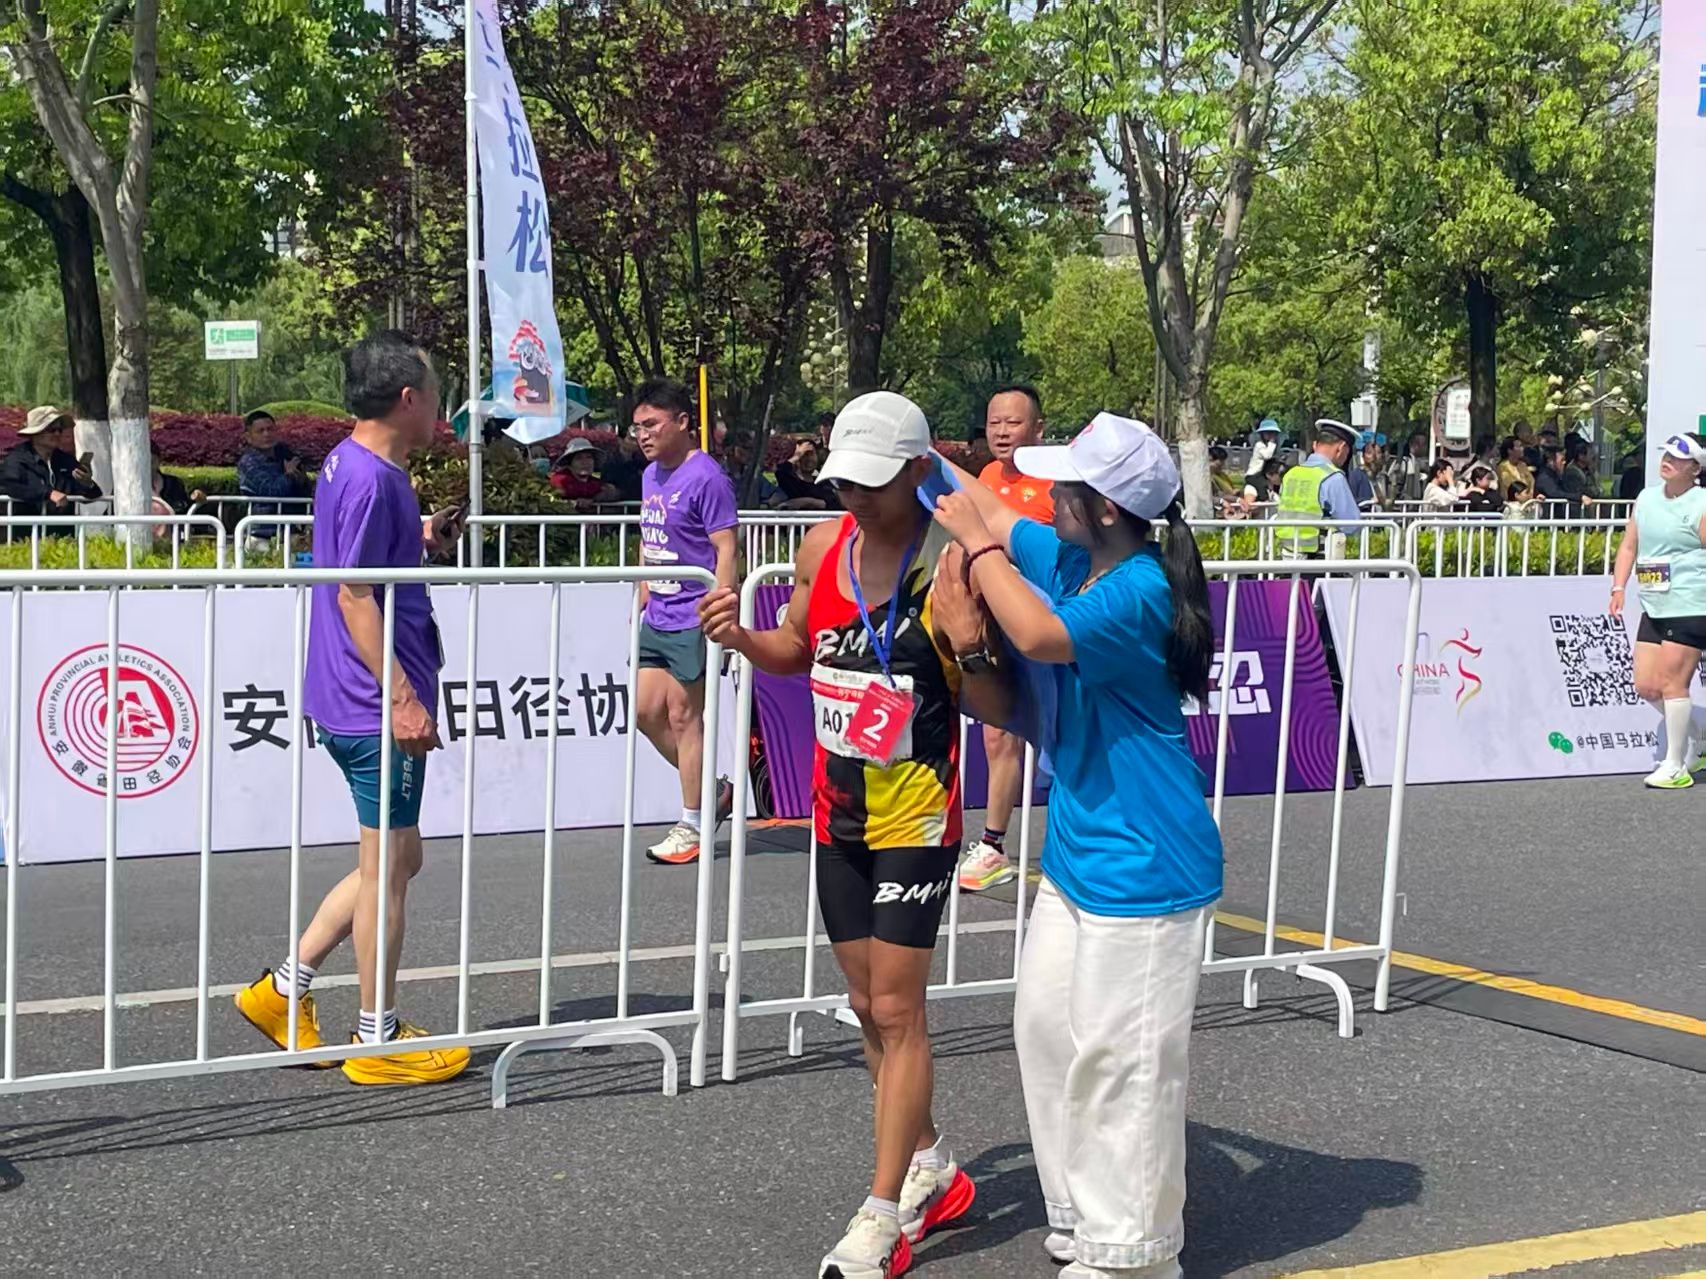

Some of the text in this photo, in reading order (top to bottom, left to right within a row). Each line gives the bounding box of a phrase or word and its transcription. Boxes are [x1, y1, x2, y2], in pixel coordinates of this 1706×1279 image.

[48, 653, 191, 736] ANHUI PROVINCIAL ATLETICS ASSOCIATION
[863, 708, 890, 743] 2
